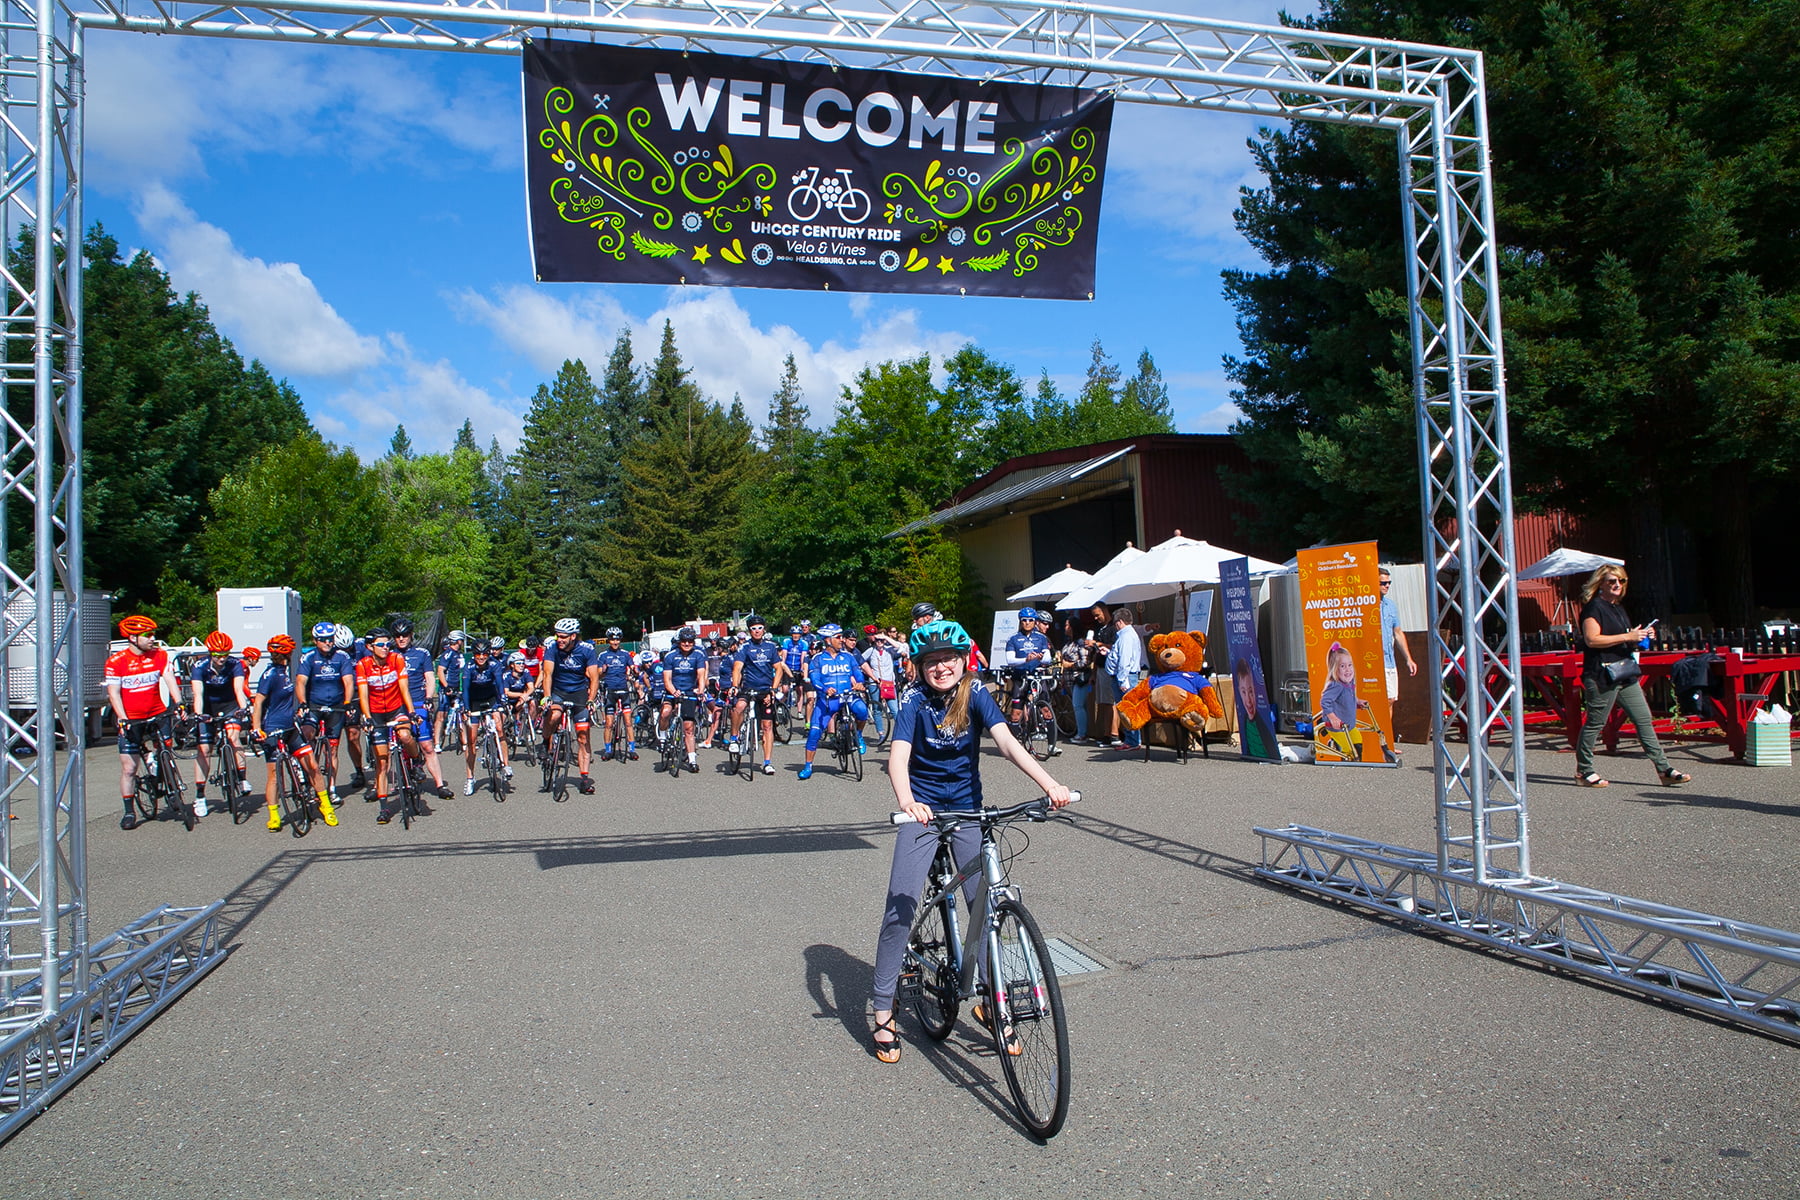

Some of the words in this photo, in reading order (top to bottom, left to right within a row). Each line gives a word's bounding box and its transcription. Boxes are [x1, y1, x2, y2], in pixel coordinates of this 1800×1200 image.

[654, 72, 999, 155] WELCOME
[751, 221, 800, 236] UHCCF
[801, 225, 866, 240] CENTURY
[867, 228, 901, 242] RIDE
[786, 240, 815, 254] Velo
[817, 242, 829, 254] &
[831, 242, 866, 256] Vines
[795, 255, 846, 266] HEALDSBURG,
[846, 258, 857, 266] CA
[1316, 576, 1343, 587] WE'RE
[1347, 575, 1360, 584] ON
[1225, 586, 1246, 598] HELPING
[1309, 590, 1315, 599] A
[1317, 586, 1355, 597] MISSION
[1357, 584, 1371, 594] TO
[1305, 598, 1341, 610] AWARD
[1226, 610, 1252, 622] CHANGING
[1319, 607, 1364, 619] MEDICAL
[1322, 618, 1363, 630] GRANTS
[1323, 631, 1335, 640] BY
[1338, 629, 1363, 639] 2020
[829, 664, 851, 673] UHC
